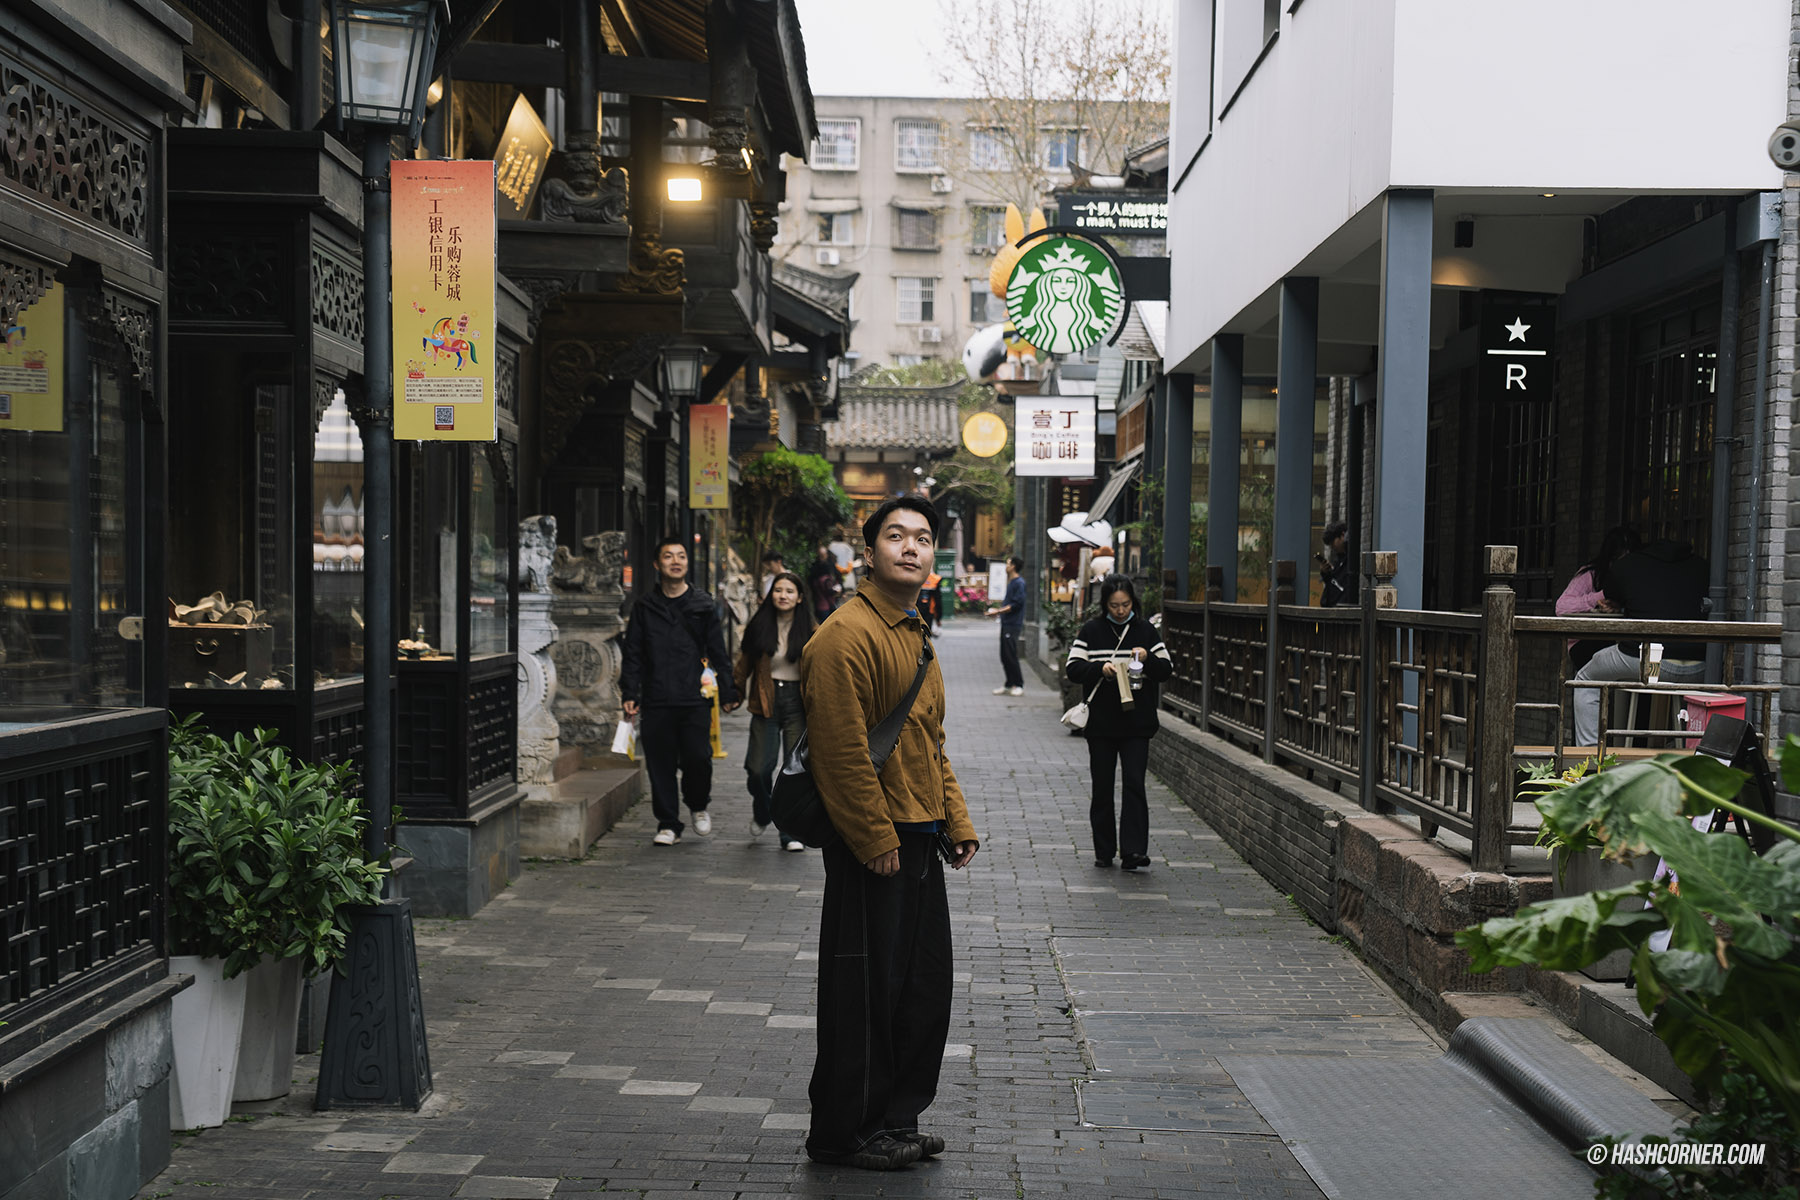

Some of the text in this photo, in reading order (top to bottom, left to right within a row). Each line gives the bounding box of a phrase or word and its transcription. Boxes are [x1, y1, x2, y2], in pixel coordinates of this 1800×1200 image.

[1076, 216, 1168, 229] a man, must be
[428, 199, 444, 292] 工银信用卡
[446, 226, 462, 302] 乐购蓉城
[1506, 363, 1528, 390] R
[1032, 410, 1079, 429] 壹丁
[1032, 441, 1078, 459] 咖啡
